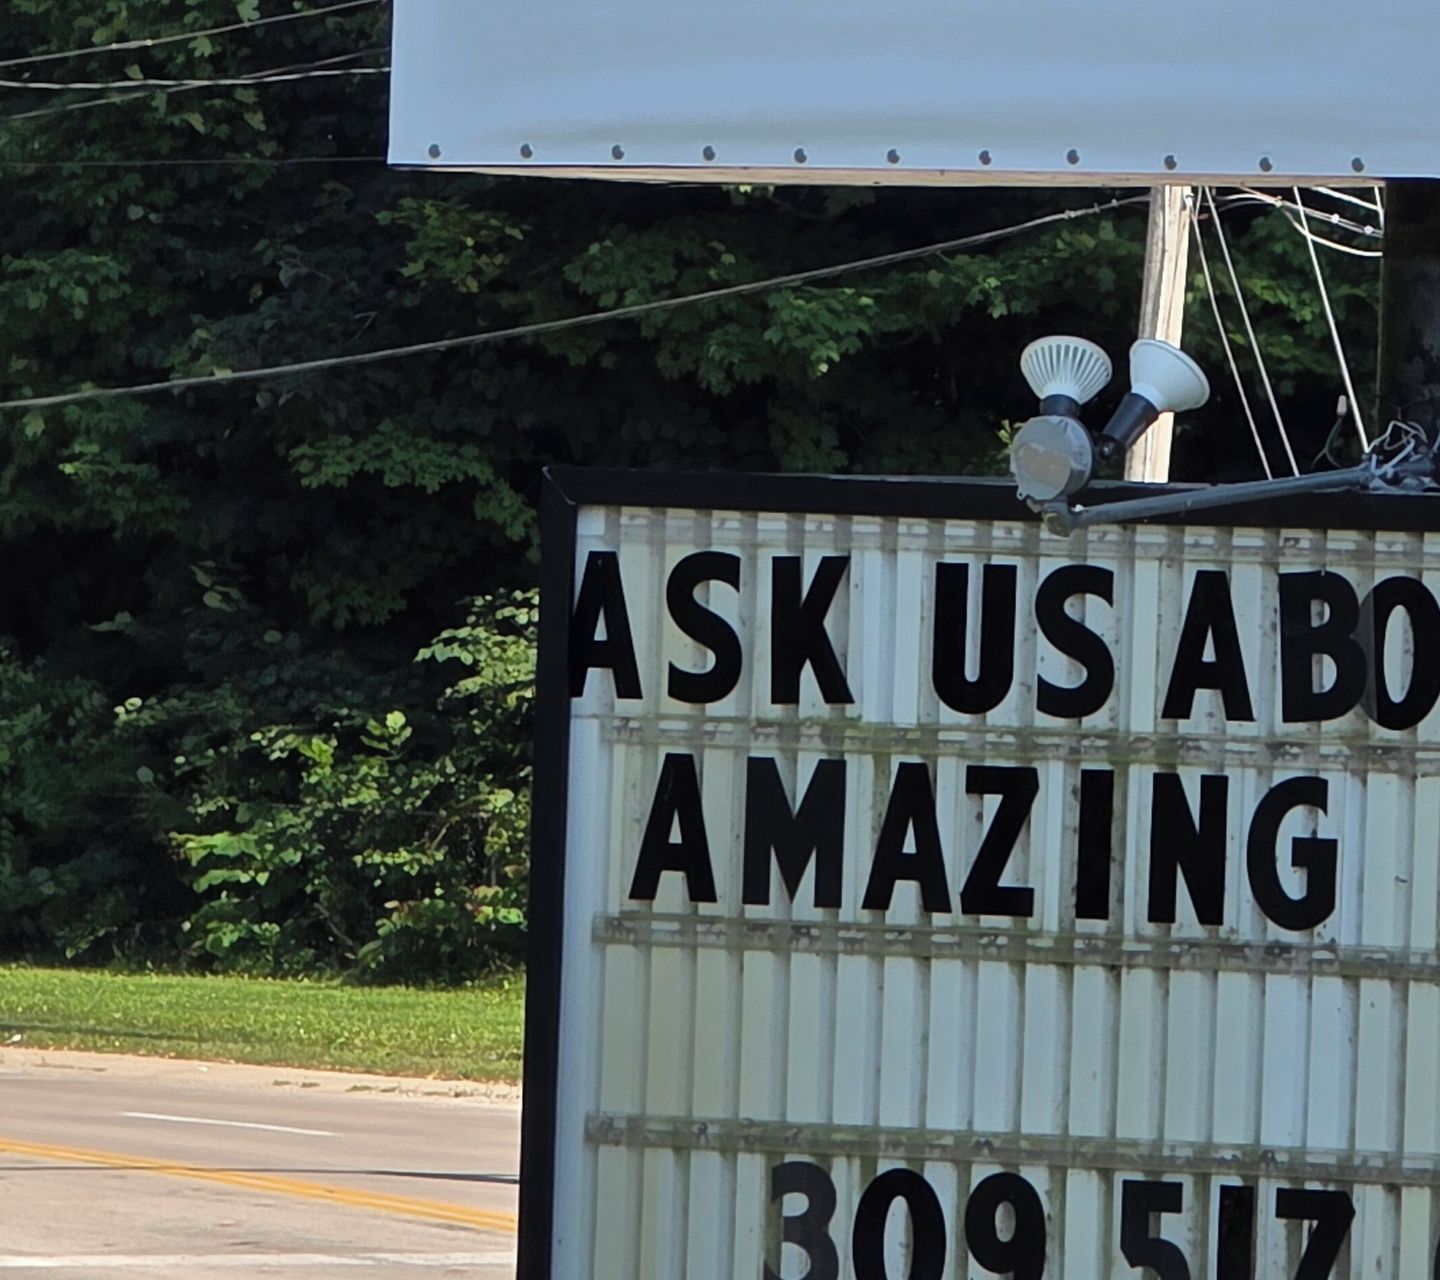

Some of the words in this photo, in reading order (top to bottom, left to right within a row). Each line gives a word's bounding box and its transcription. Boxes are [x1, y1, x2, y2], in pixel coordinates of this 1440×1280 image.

[570, 549, 855, 706] ASK
[931, 562, 1117, 719] US
[627, 751, 1340, 933] AMAZING
[764, 1160, 1048, 1280] 309
[1118, 1178, 1357, 1280] 517
